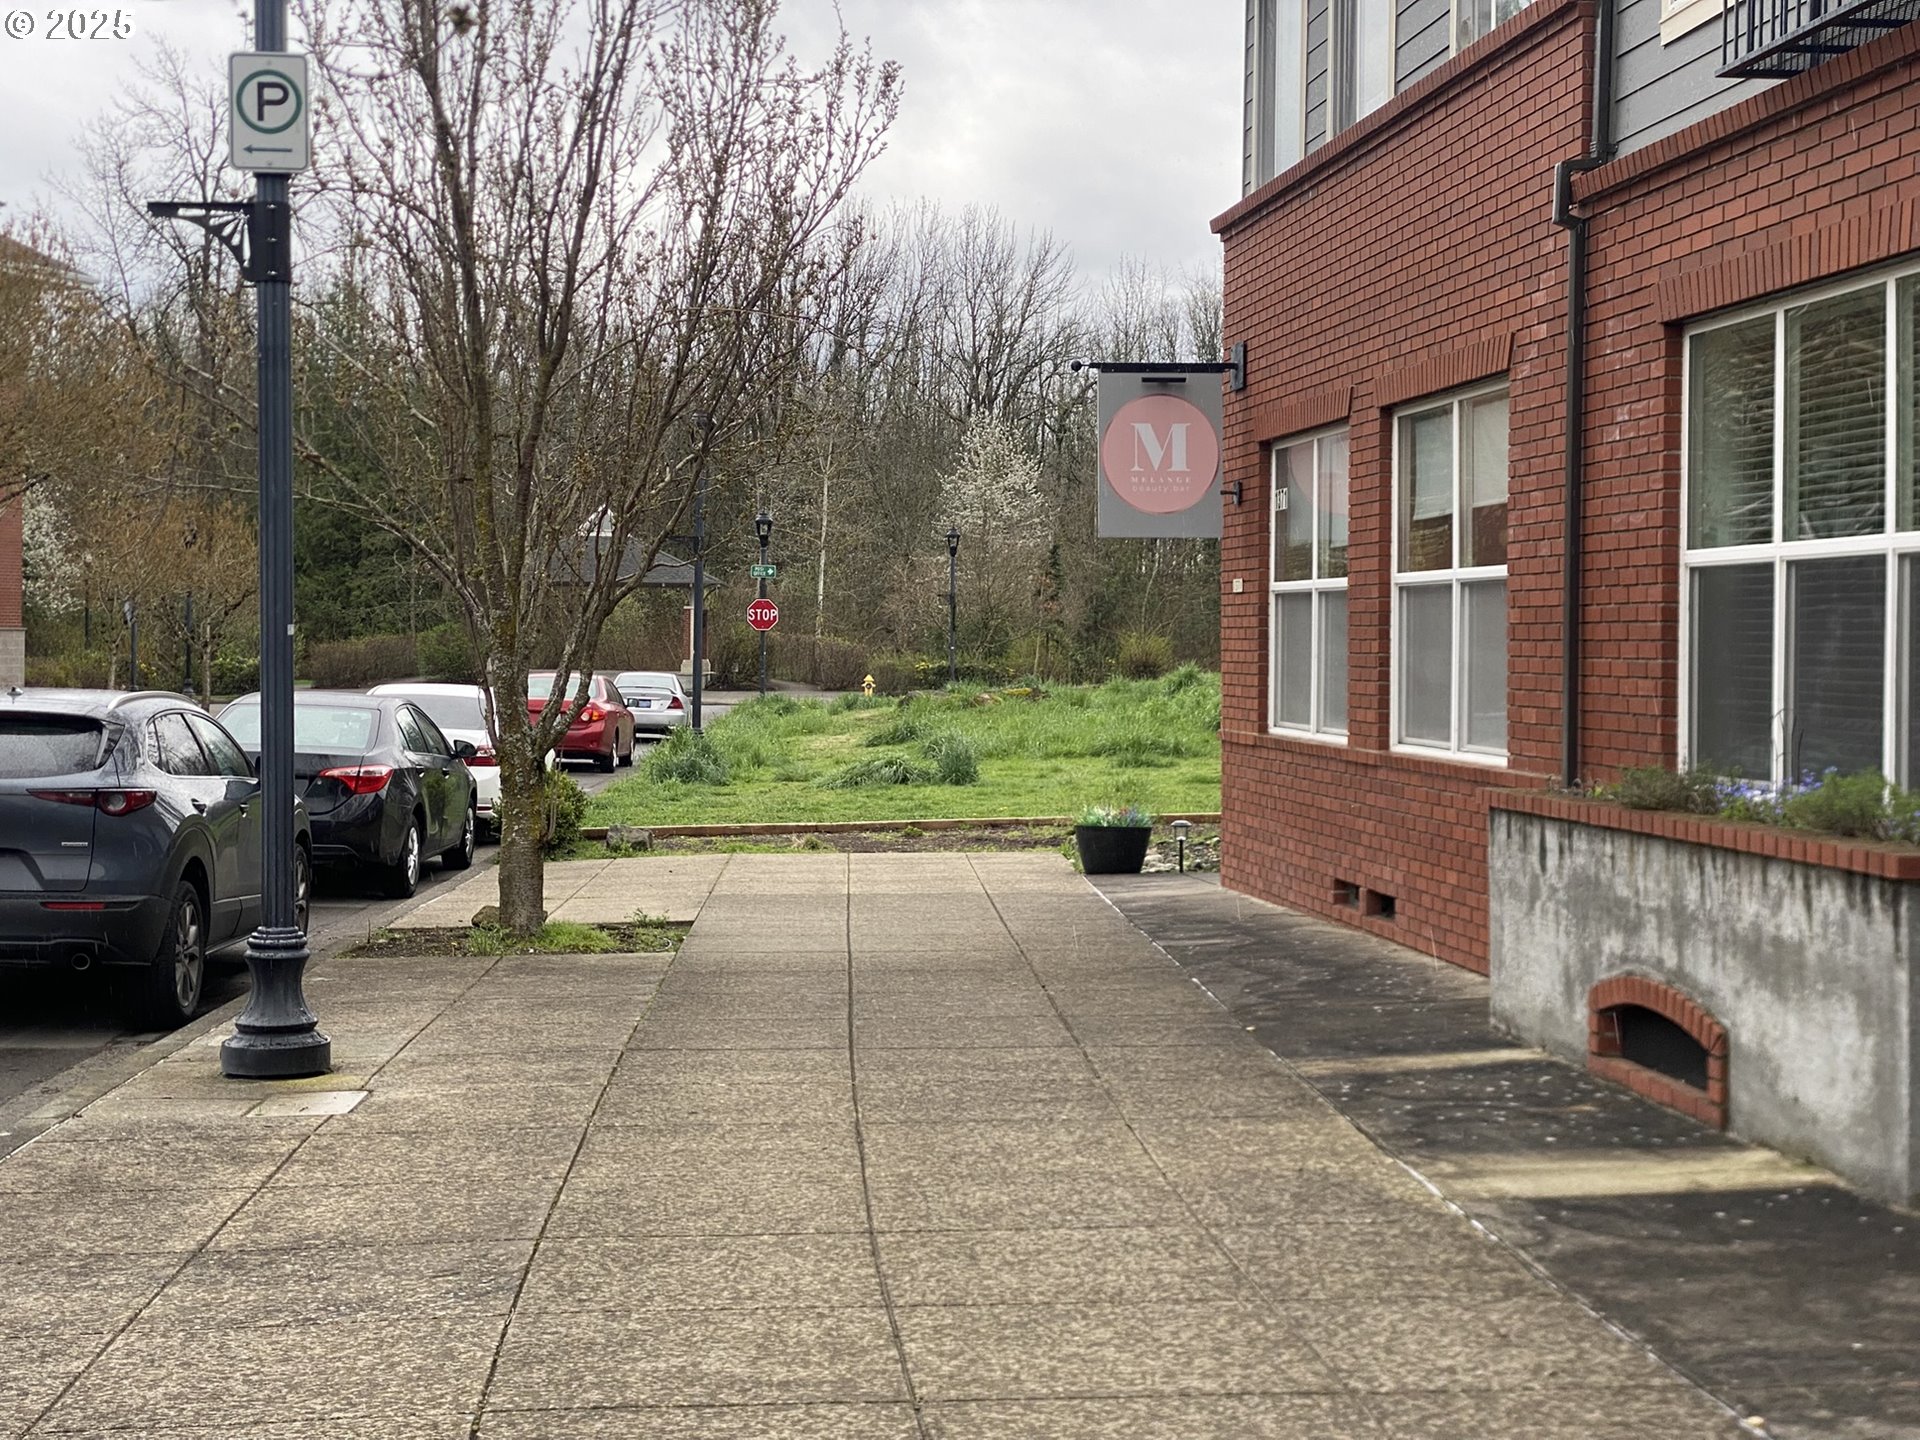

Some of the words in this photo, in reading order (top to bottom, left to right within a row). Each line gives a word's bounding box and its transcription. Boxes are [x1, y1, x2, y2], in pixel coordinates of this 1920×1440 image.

[256, 81, 290, 122] P
[1130, 422, 1192, 472] M
[1132, 485, 1169, 493] beauty
[748, 608, 777, 621] STOP
